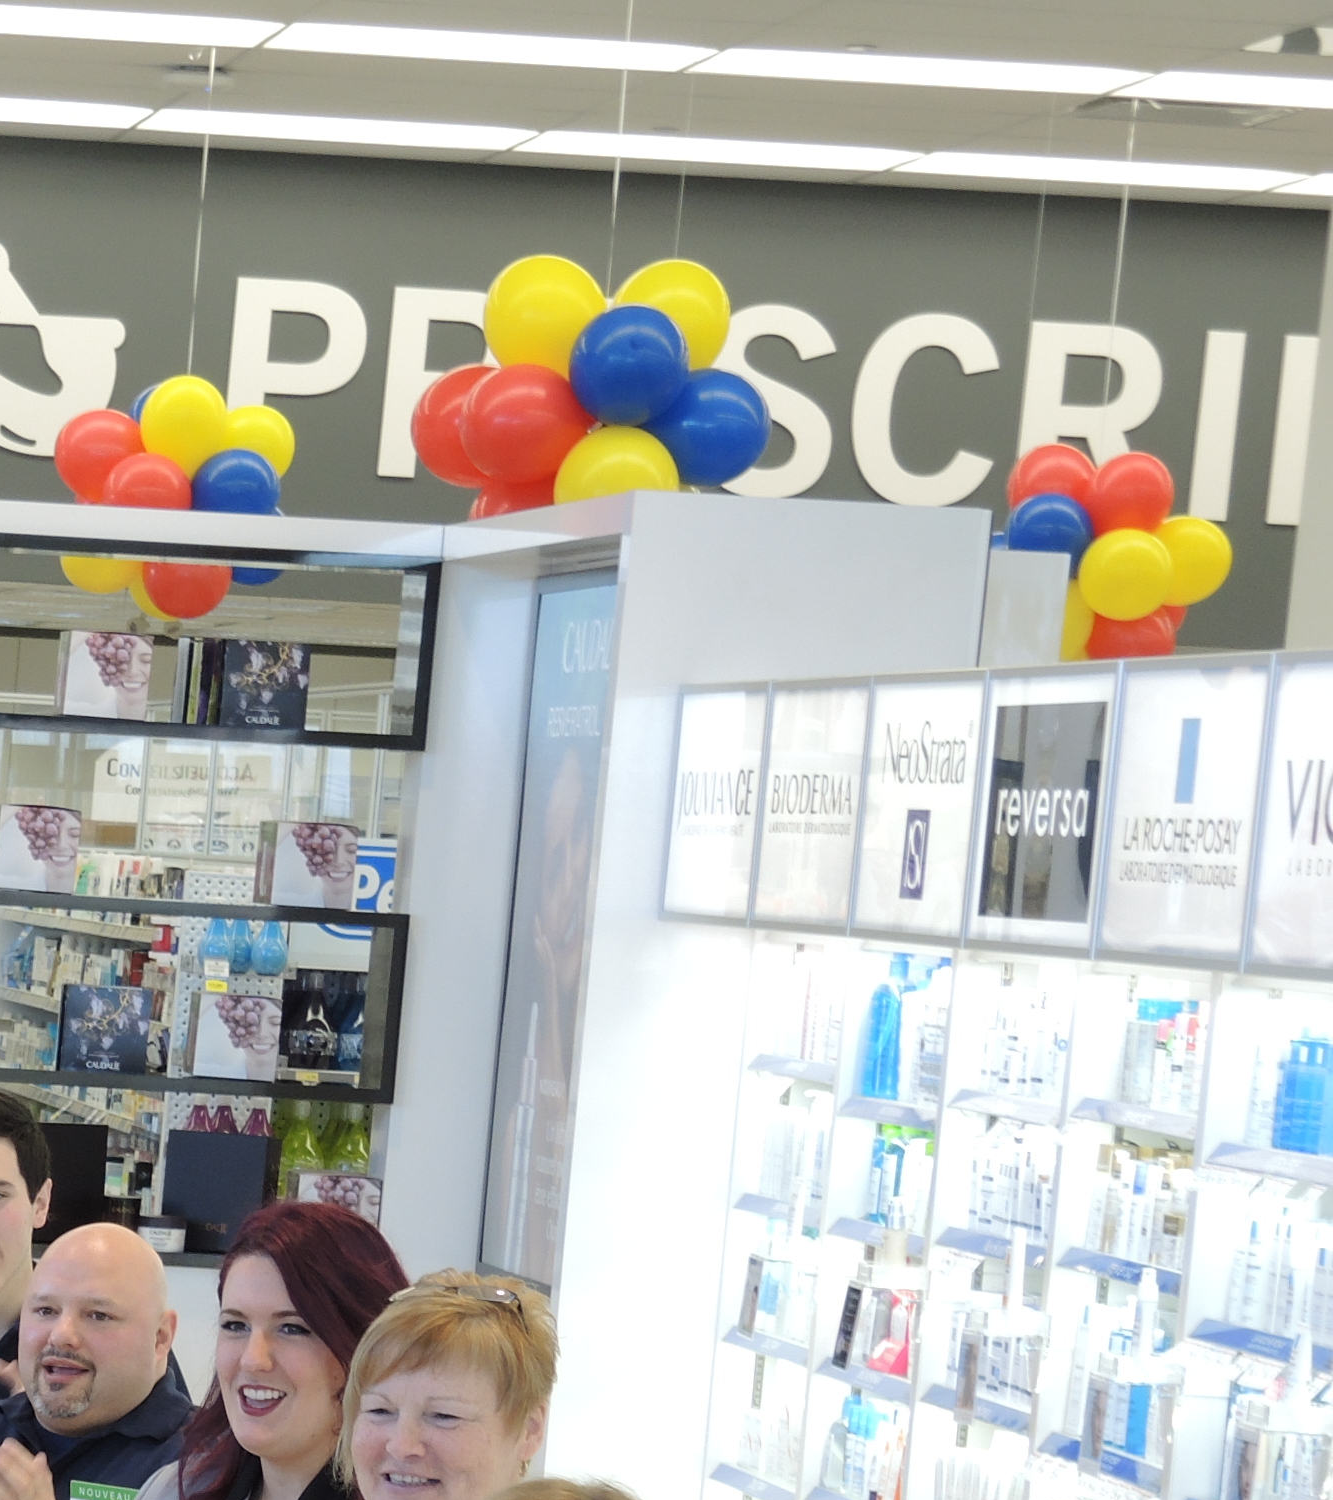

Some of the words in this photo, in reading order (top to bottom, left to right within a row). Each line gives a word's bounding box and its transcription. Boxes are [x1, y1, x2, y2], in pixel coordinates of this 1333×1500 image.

[227, 276, 1319, 526] PRSCRI
[883, 720, 967, 785] NeoStrata
[677, 769, 754, 829] JOUVIANCE
[770, 774, 852, 816] BIODERMA
[995, 787, 1090, 838] reversa
[1123, 816, 1139, 851] LA
[1143, 817, 1243, 856] ROCHE-POSAY
